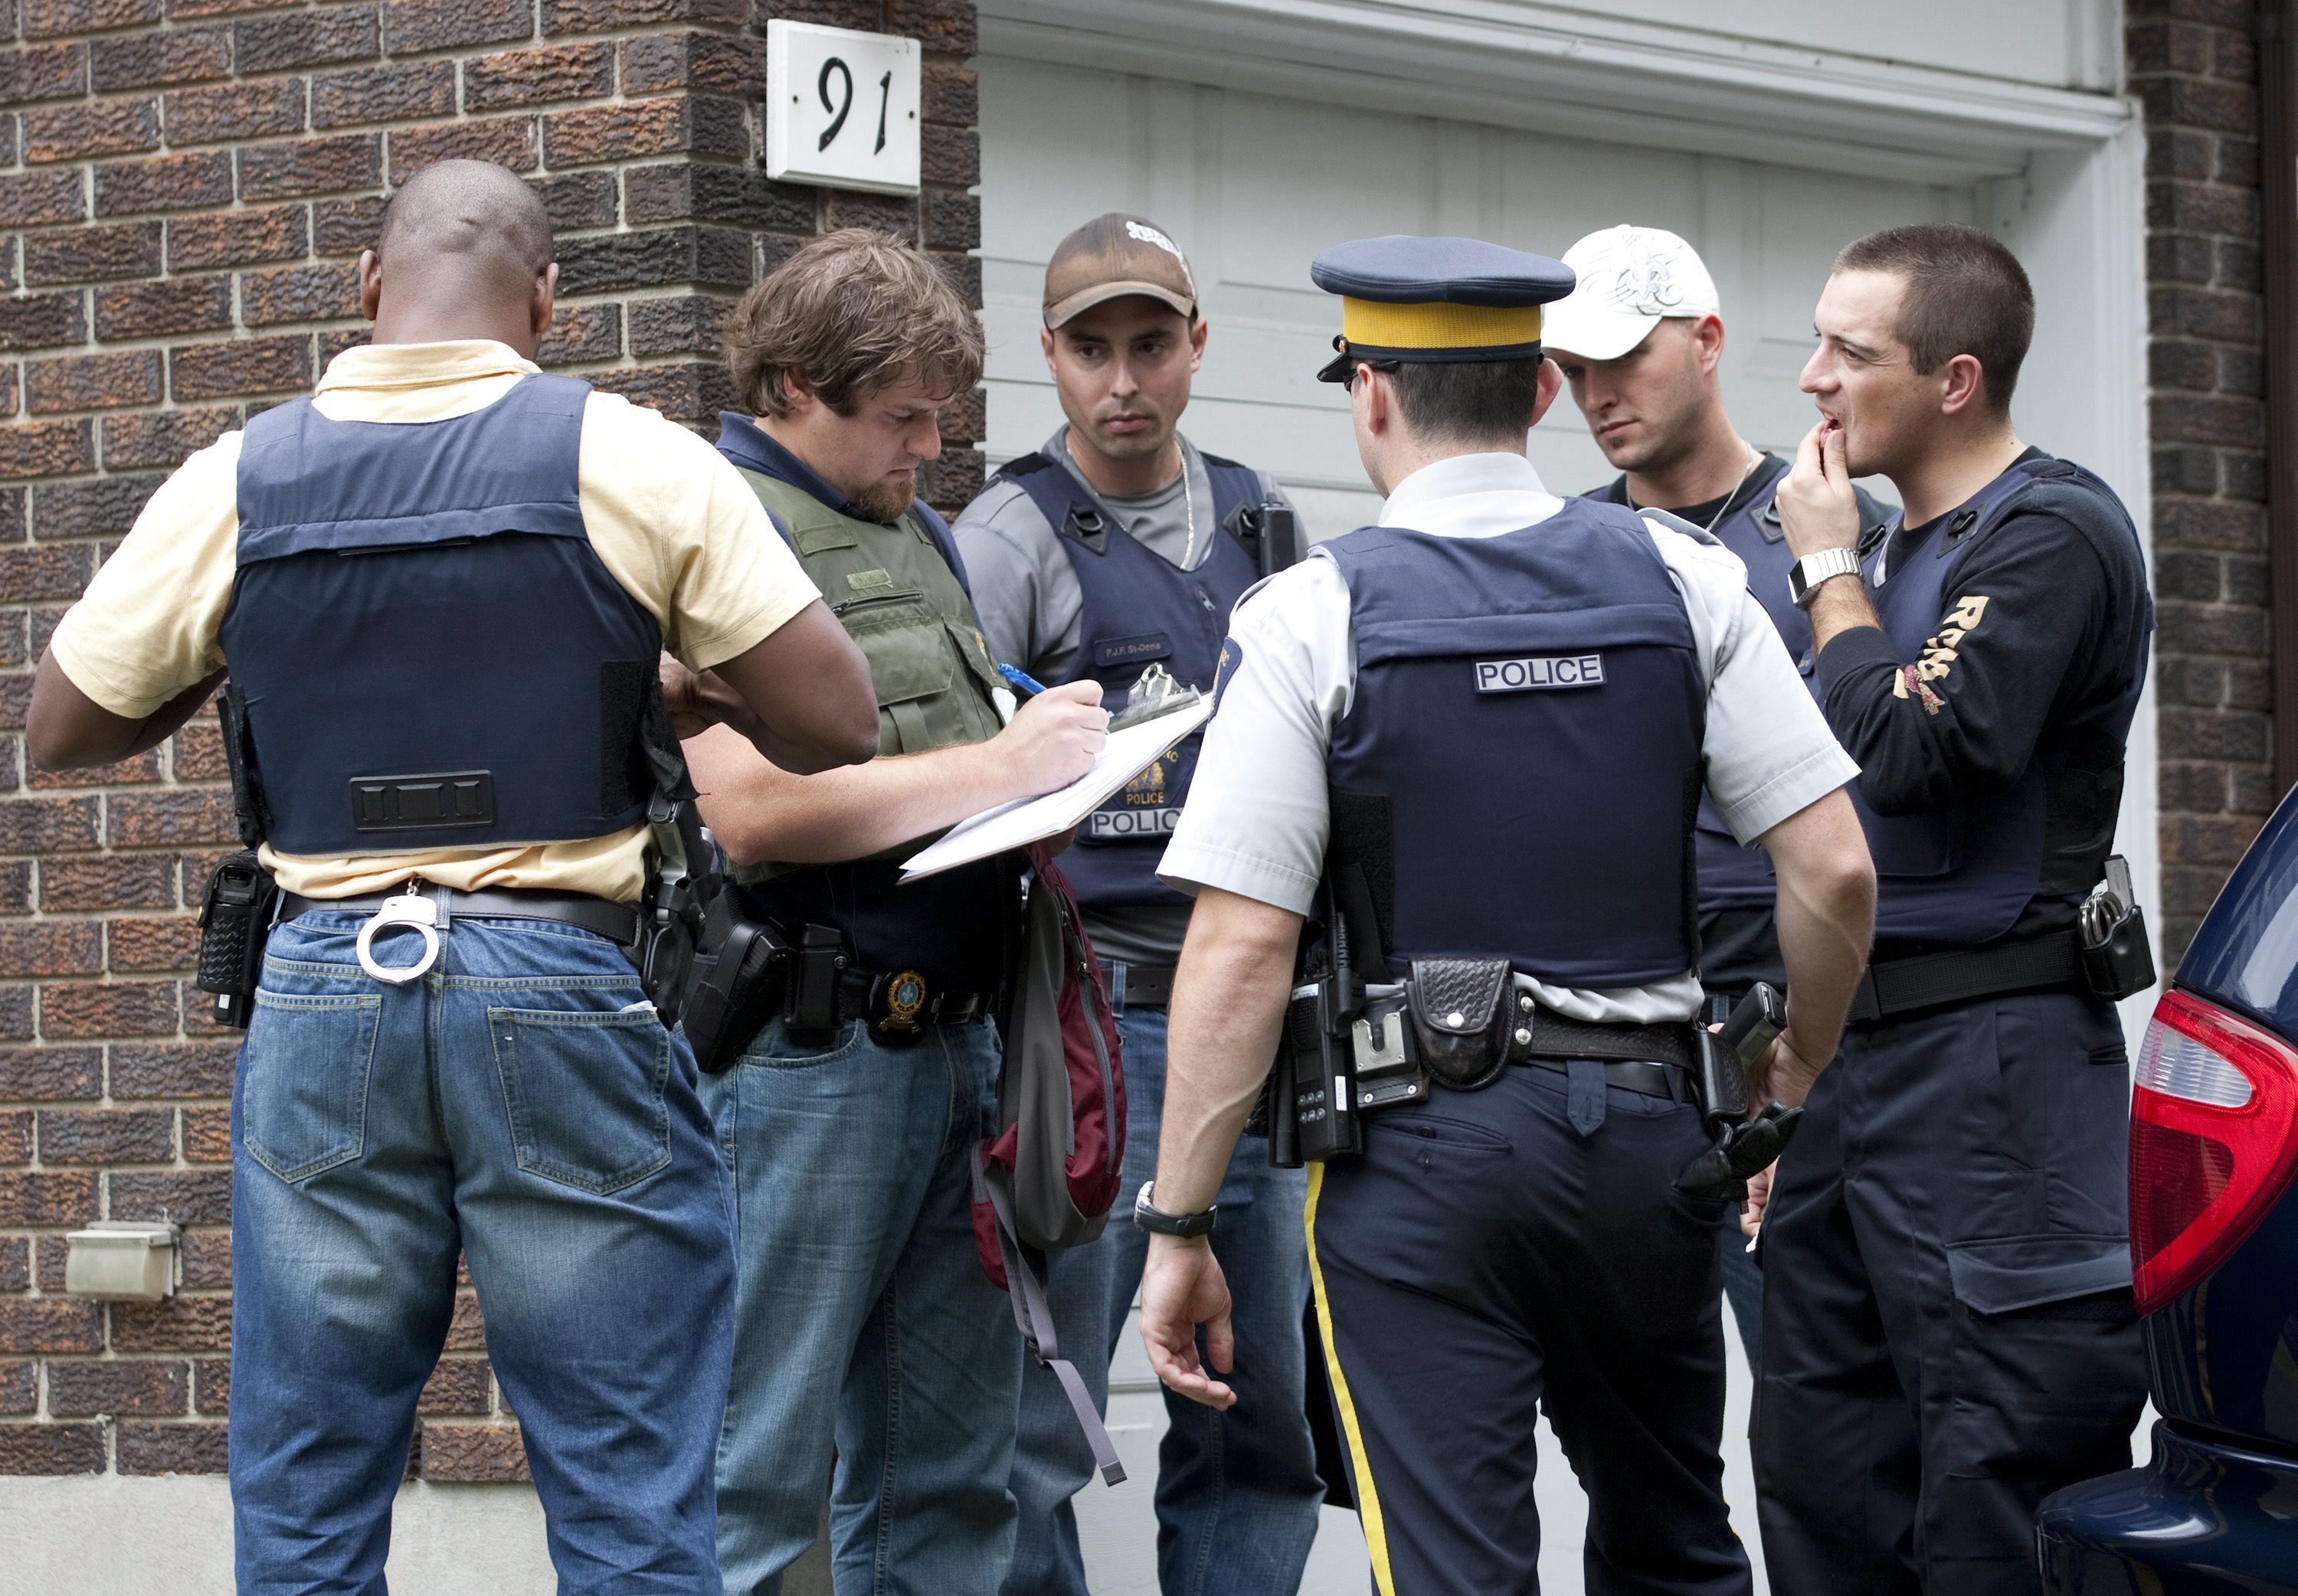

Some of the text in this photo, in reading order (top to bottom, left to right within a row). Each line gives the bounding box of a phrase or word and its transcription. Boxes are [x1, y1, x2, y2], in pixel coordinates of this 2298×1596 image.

[818, 57, 891, 155] 91
[1479, 656, 1600, 688] POLICE
[1127, 791, 1164, 805] POLICE
[1094, 810, 1180, 833] POLIC
